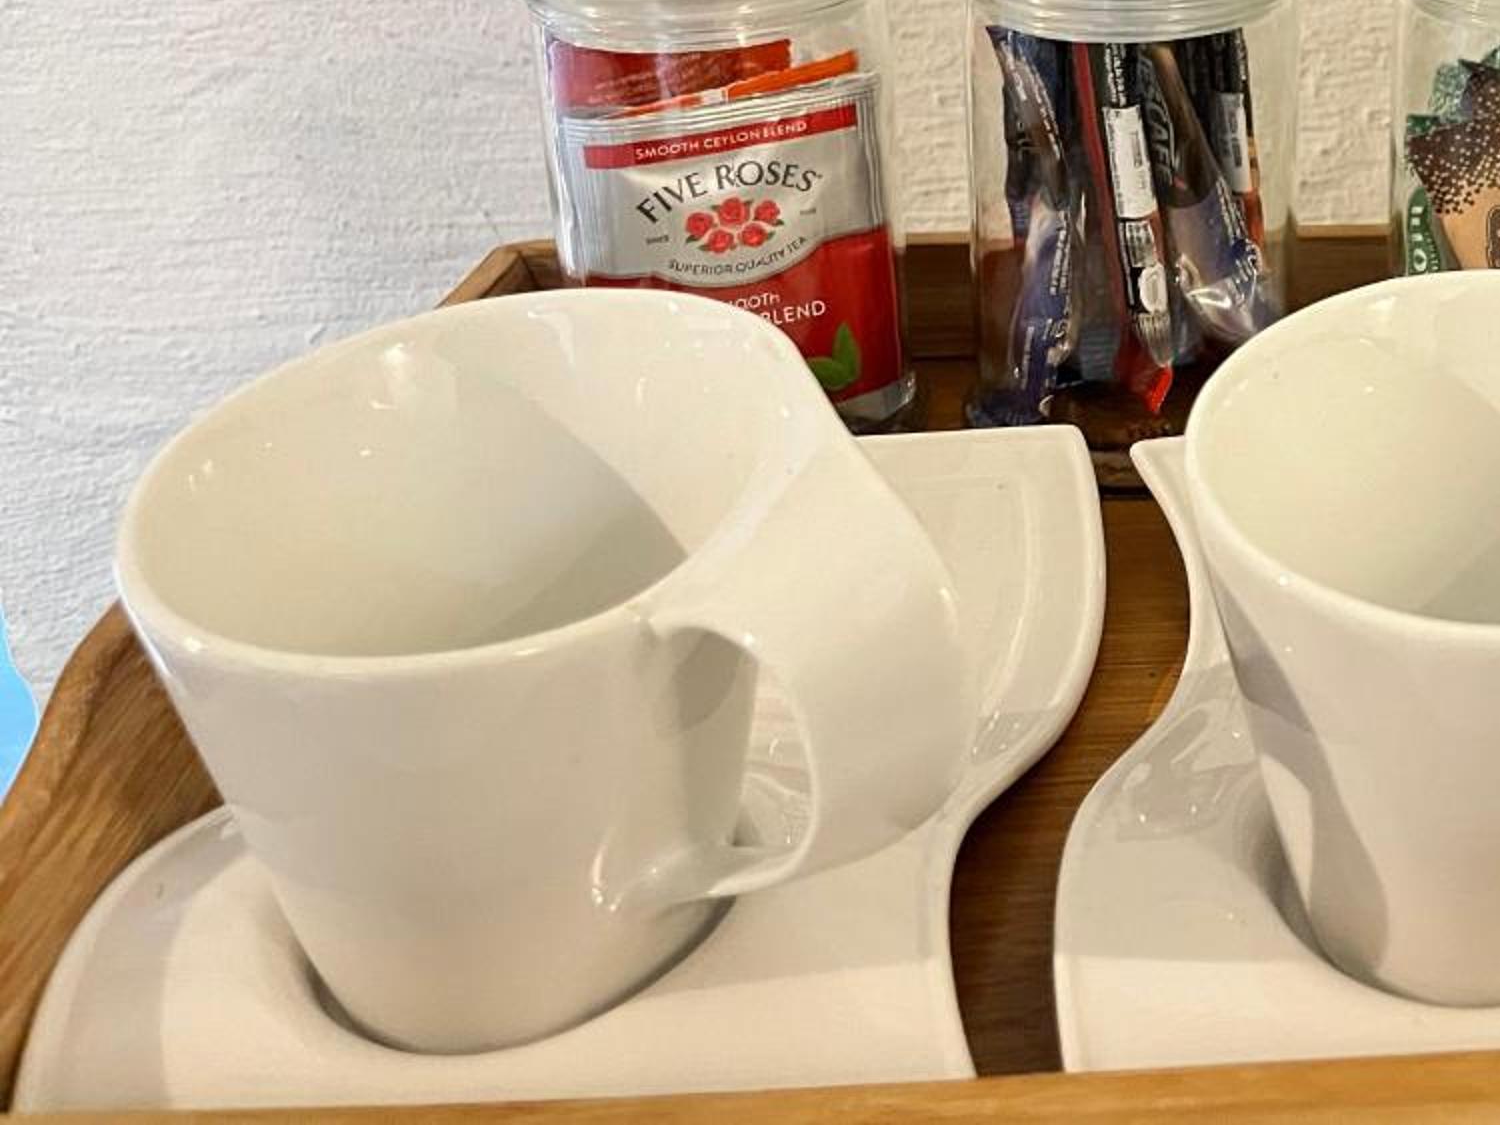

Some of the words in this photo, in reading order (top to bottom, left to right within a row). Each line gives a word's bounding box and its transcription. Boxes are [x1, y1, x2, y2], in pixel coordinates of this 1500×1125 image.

[635, 141, 699, 160] SMOOTH
[703, 129, 761, 149] CEYLON
[762, 120, 808, 139] BLEND
[636, 172, 708, 224] FIVE
[714, 160, 813, 192] ROSES
[668, 258, 733, 276] SUPERIOR
[735, 249, 786, 272] QUALITY
[787, 236, 807, 254] TEA
